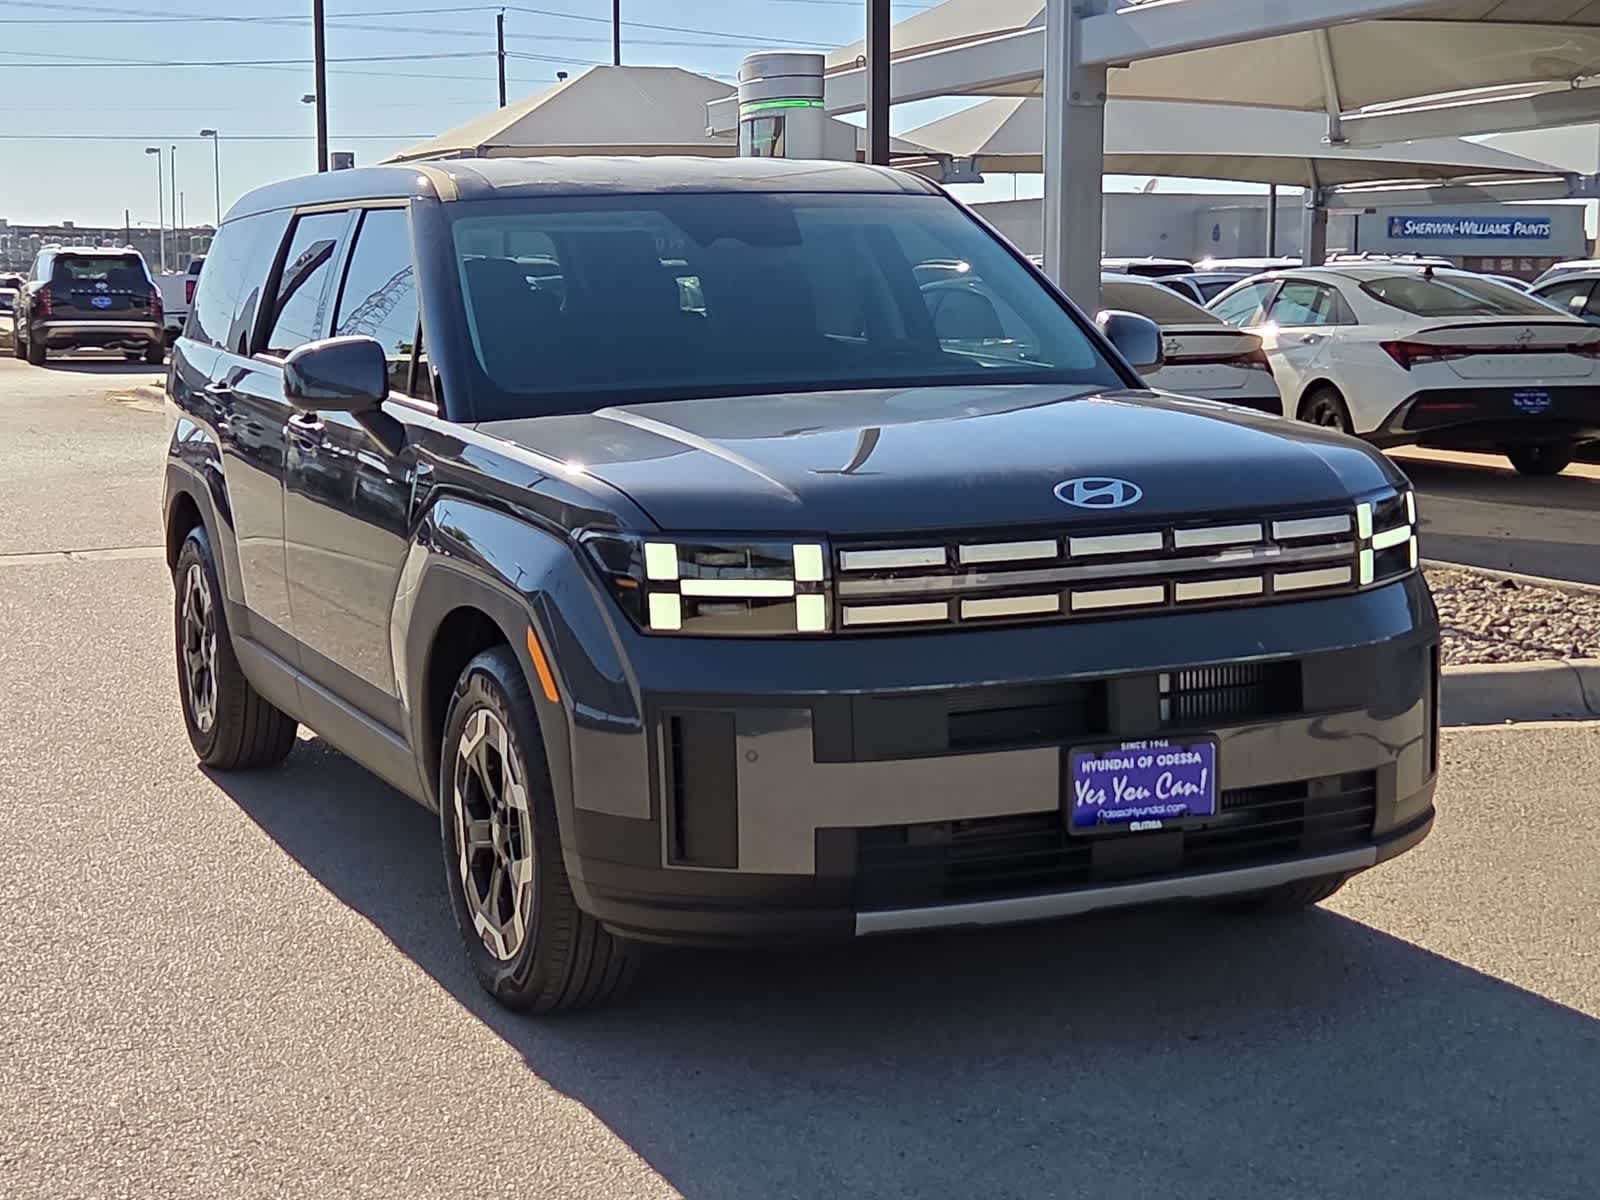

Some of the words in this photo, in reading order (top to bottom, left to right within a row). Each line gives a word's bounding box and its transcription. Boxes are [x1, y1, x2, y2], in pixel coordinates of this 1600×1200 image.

[1404, 219, 1510, 235] SHERWIN-WILLIAMS
[1513, 221, 1550, 235] PAINTS
[1082, 757, 1134, 774] HYUNDAI
[1137, 755, 1154, 769] OF
[1156, 752, 1202, 767] ODESSA
[1074, 778, 1107, 807] Yes
[1112, 775, 1152, 804] You
[1155, 767, 1208, 800] Can!
